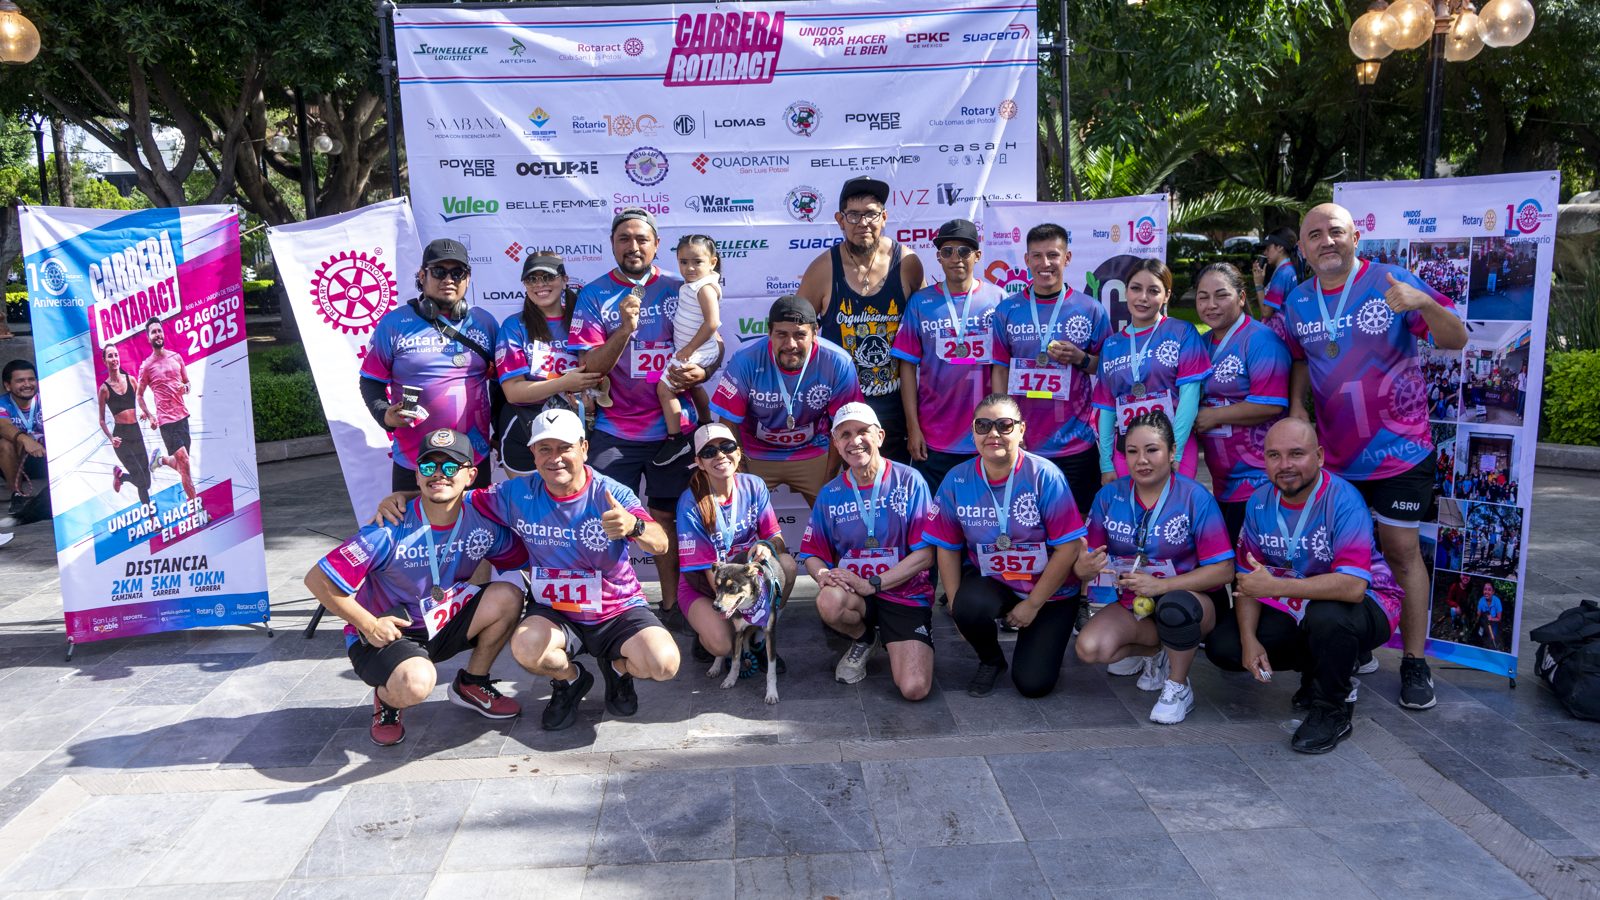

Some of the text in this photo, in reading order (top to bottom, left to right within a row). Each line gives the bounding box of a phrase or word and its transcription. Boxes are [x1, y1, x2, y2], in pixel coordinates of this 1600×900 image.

[674, 11, 785, 50] CARRERA
[799, 26, 845, 37] UNIDOS
[962, 29, 1021, 43] suacero
[813, 34, 886, 46] PARA HACER
[906, 32, 950, 43] CPKC
[413, 43, 488, 54] SCHNELLECKE
[577, 43, 621, 52] Rotaract
[844, 45, 888, 56] EL BIEN
[671, 51, 777, 83] ROTARACT
[961, 106, 996, 116] Rotary
[715, 118, 766, 127] LOMAS
[845, 112, 900, 123] POWER
[426, 117, 508, 131] SAABANA
[572, 121, 606, 129] Rotario
[439, 159, 495, 169] POWER
[712, 155, 790, 169] QUADRATIN
[811, 157, 859, 168] BELLE
[613, 191, 670, 203] San Luis
[700, 195, 730, 206] War
[442, 196, 499, 214] Valeo
[506, 200, 549, 209] BELLE
[613, 203, 670, 214] able
[703, 204, 755, 213] MARKETING
[1403, 209, 1421, 218] UNIDOS
[1422, 217, 1437, 225] HACER
[1463, 214, 1483, 227] Rotary
[993, 231, 1012, 239] Rotaract
[1093, 229, 1110, 239] Rotary
[1425, 225, 1437, 233] BIEN
[897, 228, 940, 243] CPK
[789, 237, 844, 250] suace
[1128, 246, 1163, 254] Aniversario
[88, 230, 175, 302] CARRERA
[359, 260, 389, 317] INTERNATIONAL
[766, 281, 800, 290] Rotario
[33, 296, 84, 308] Aniversario
[319, 283, 336, 317] ROTARY
[99, 277, 177, 342] ROTARACT
[175, 295, 240, 334] 03 AGOSTO
[602, 303, 662, 324] Roact
[836, 311, 902, 328] Orgullosamen
[921, 315, 980, 333] Rotaact
[739, 318, 769, 334] Val
[1007, 321, 1062, 335] Rotaat
[186, 312, 239, 357] 2025
[397, 335, 455, 350] Rotarac
[1103, 350, 1153, 374] Rotart
[1019, 373, 1061, 392] 175
[749, 388, 803, 403] Rotart
[766, 400, 779, 409] Luis
[764, 433, 807, 444] 209
[1361, 437, 1431, 464] Aniver
[828, 496, 887, 518] Rotaact
[957, 504, 1011, 518] otara
[1391, 500, 1420, 511] ASRU
[108, 500, 157, 534] UNIDOS
[128, 497, 203, 542] PARA HACER
[847, 514, 860, 522] Luis
[968, 519, 982, 527] Luis
[162, 510, 210, 543] EL BIEN
[516, 519, 577, 541] Rotaract
[1103, 516, 1161, 537] Rotart
[535, 535, 548, 546] Luis
[1116, 534, 1130, 544] Luis
[1271, 549, 1282, 557] Luis
[125, 555, 209, 577] DISTANCIA
[404, 560, 418, 569] San
[989, 555, 1037, 572] 357
[111, 570, 225, 595] 2KM 5KM 10KM
[195, 584, 221, 592] CARRERA
[111, 592, 143, 601] CAMINATA
[152, 588, 180, 596] CARRERA
[541, 583, 592, 605] 411
[196, 607, 214, 615] Rotary
[93, 615, 118, 625] San Luis
